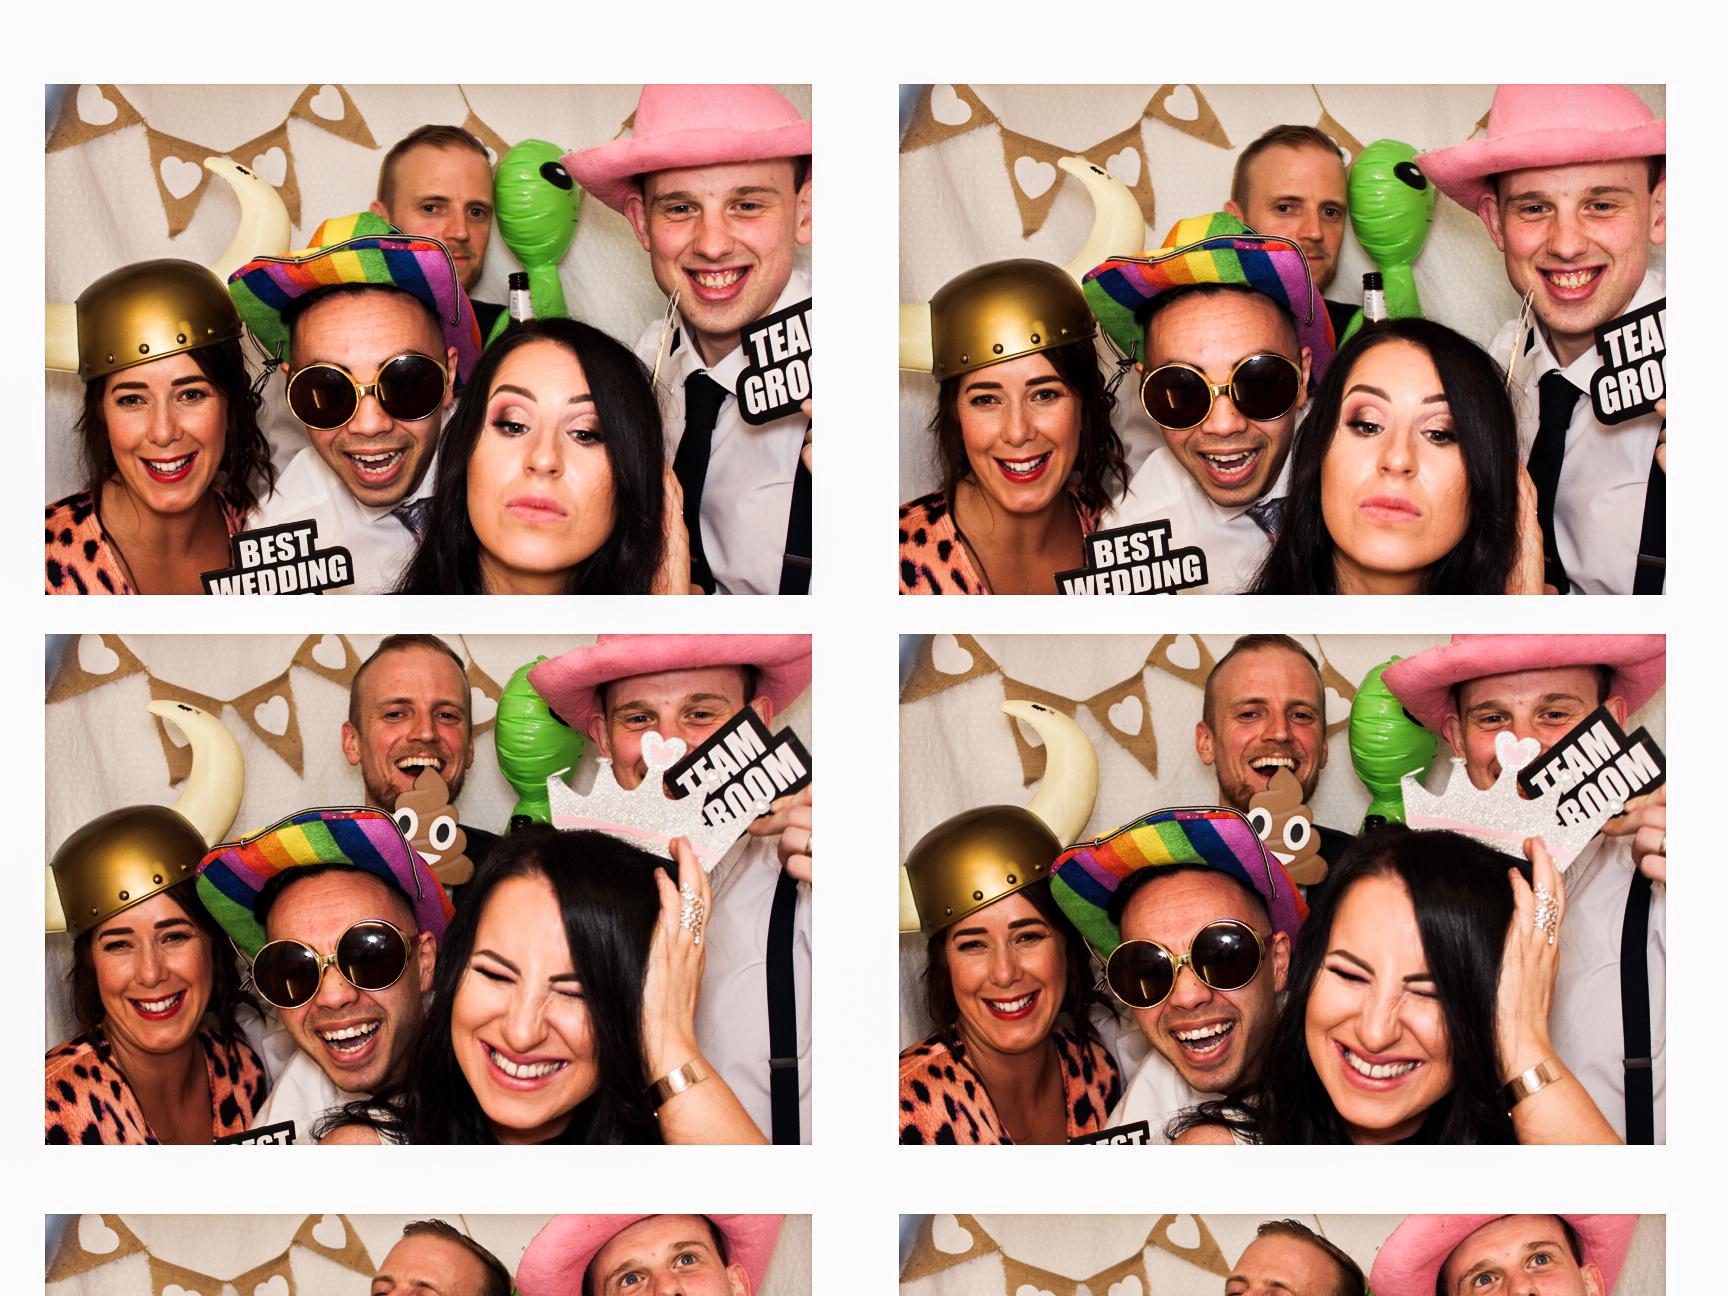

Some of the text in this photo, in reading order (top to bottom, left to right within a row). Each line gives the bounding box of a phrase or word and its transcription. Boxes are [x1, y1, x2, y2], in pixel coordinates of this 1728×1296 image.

[744, 355, 812, 415] GRO
[1598, 355, 1666, 415] GRO
[239, 528, 312, 569] BEST
[1093, 528, 1166, 569] BEST
